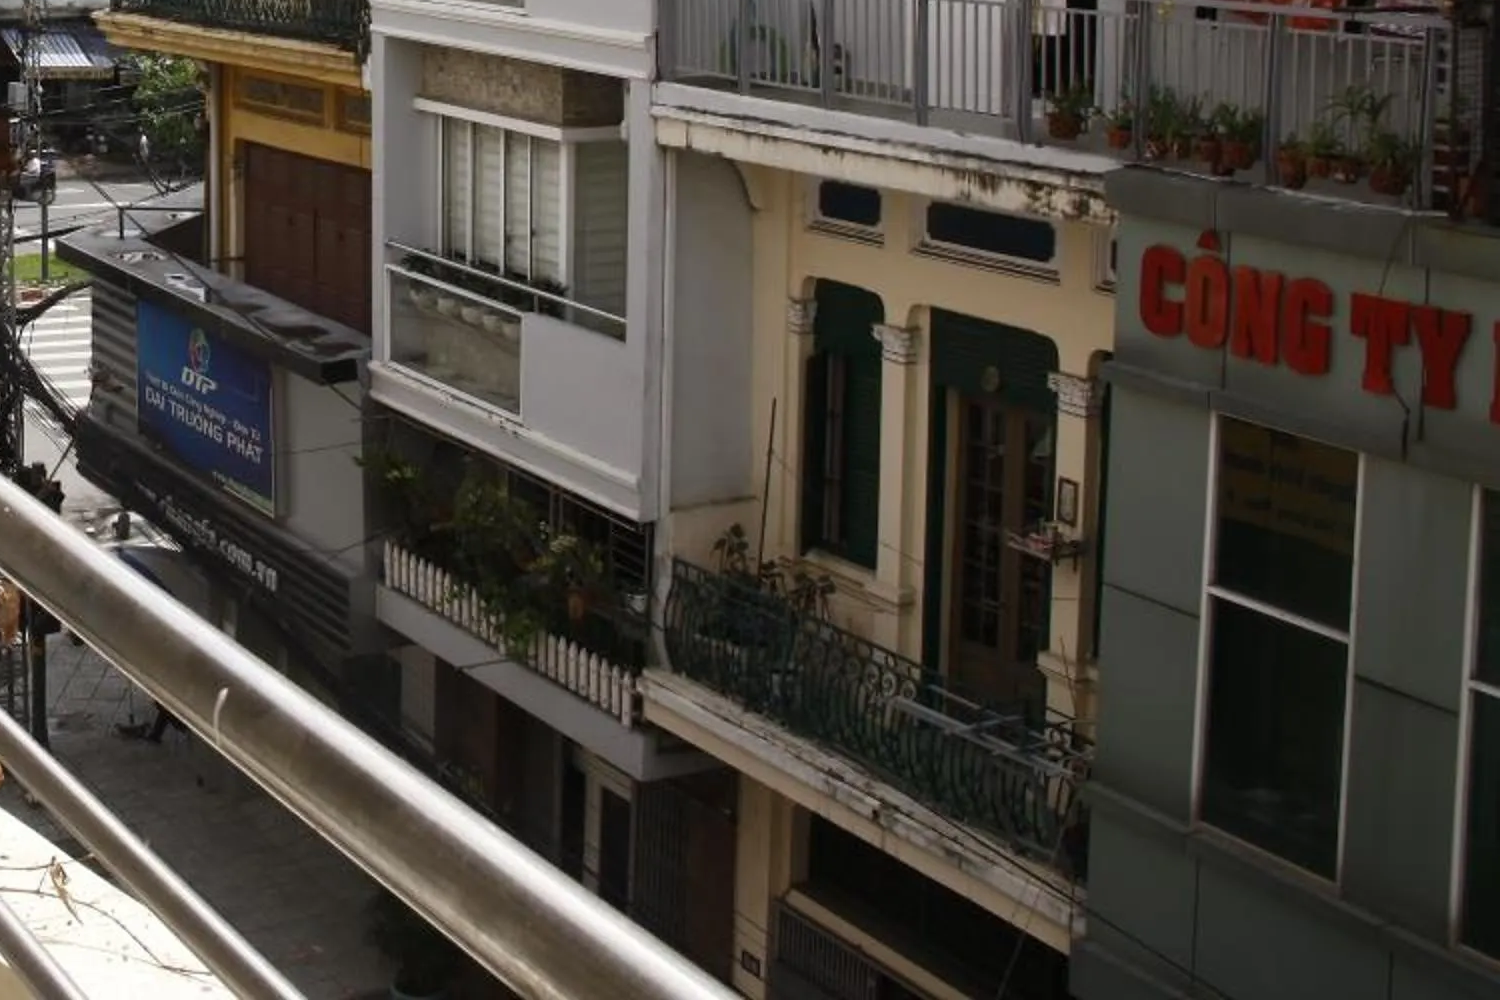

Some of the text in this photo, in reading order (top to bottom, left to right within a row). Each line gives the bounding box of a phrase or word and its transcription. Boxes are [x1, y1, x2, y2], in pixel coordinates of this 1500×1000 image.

[1139, 229, 1334, 378] CÔNG
[1350, 291, 1473, 411] TY
[180, 366, 218, 395] DTP
